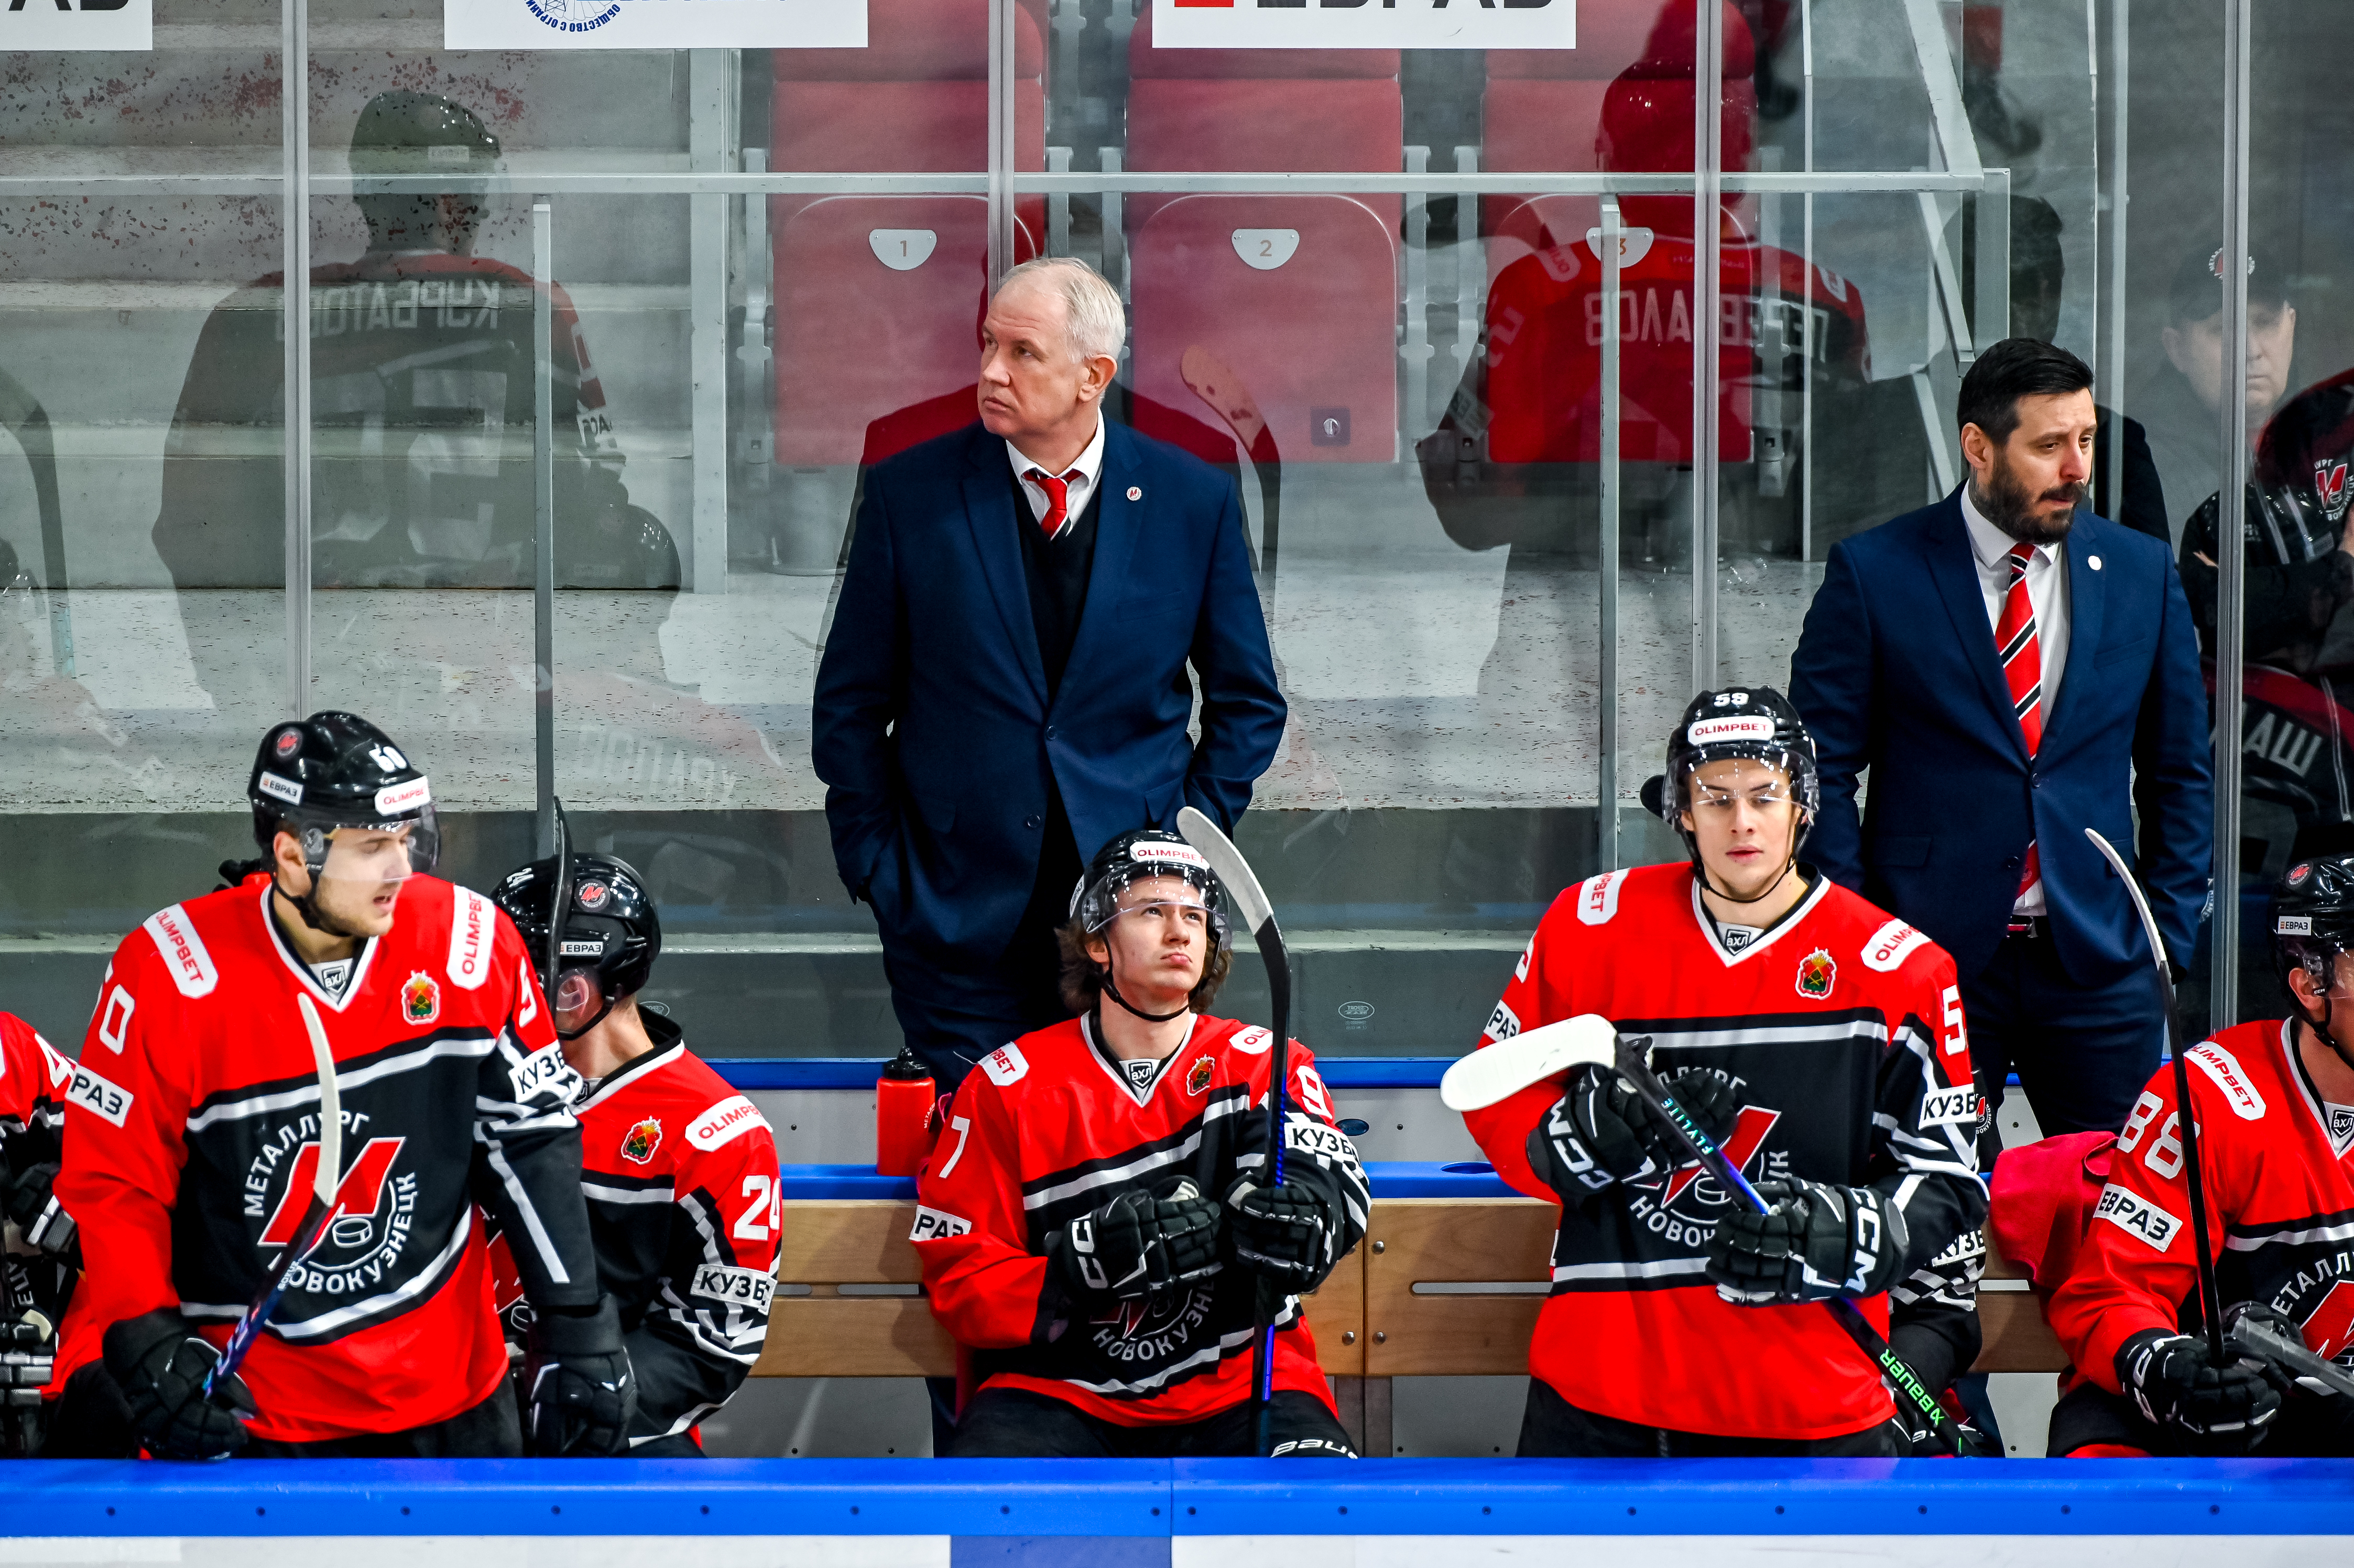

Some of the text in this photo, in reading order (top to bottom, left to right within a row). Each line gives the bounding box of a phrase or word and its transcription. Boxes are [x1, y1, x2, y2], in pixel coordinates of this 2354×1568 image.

[569, 4, 620, 32] ОБЩЕСТВО
[900, 241, 907, 257] 1
[1259, 240, 1272, 257] 2
[1619, 238, 1627, 255] 3
[1714, 692, 1749, 707] 59
[1694, 723, 1768, 736] OLIMPBET
[368, 746, 407, 774] 50
[269, 779, 298, 797] ЕВРАЗ
[2285, 921, 2308, 930] ЕВРАЗ
[565, 944, 602, 953] ЕВРАЗ
[1943, 984, 1967, 1056] 5
[1131, 1067, 1152, 1081] ВХЛ
[1661, 1098, 1714, 1155] FLYLITE
[2333, 1117, 2353, 1128] ВХЛ
[1549, 1095, 1615, 1190] CCM
[2118, 1091, 2199, 1179] 88
[244, 1110, 369, 1216] МЕТАЛЛРГ
[2098, 1191, 2171, 1241] ЕВРАЗ
[1844, 1188, 1881, 1293] CCM
[2270, 1251, 2354, 1316] ЕТАЛЛ
